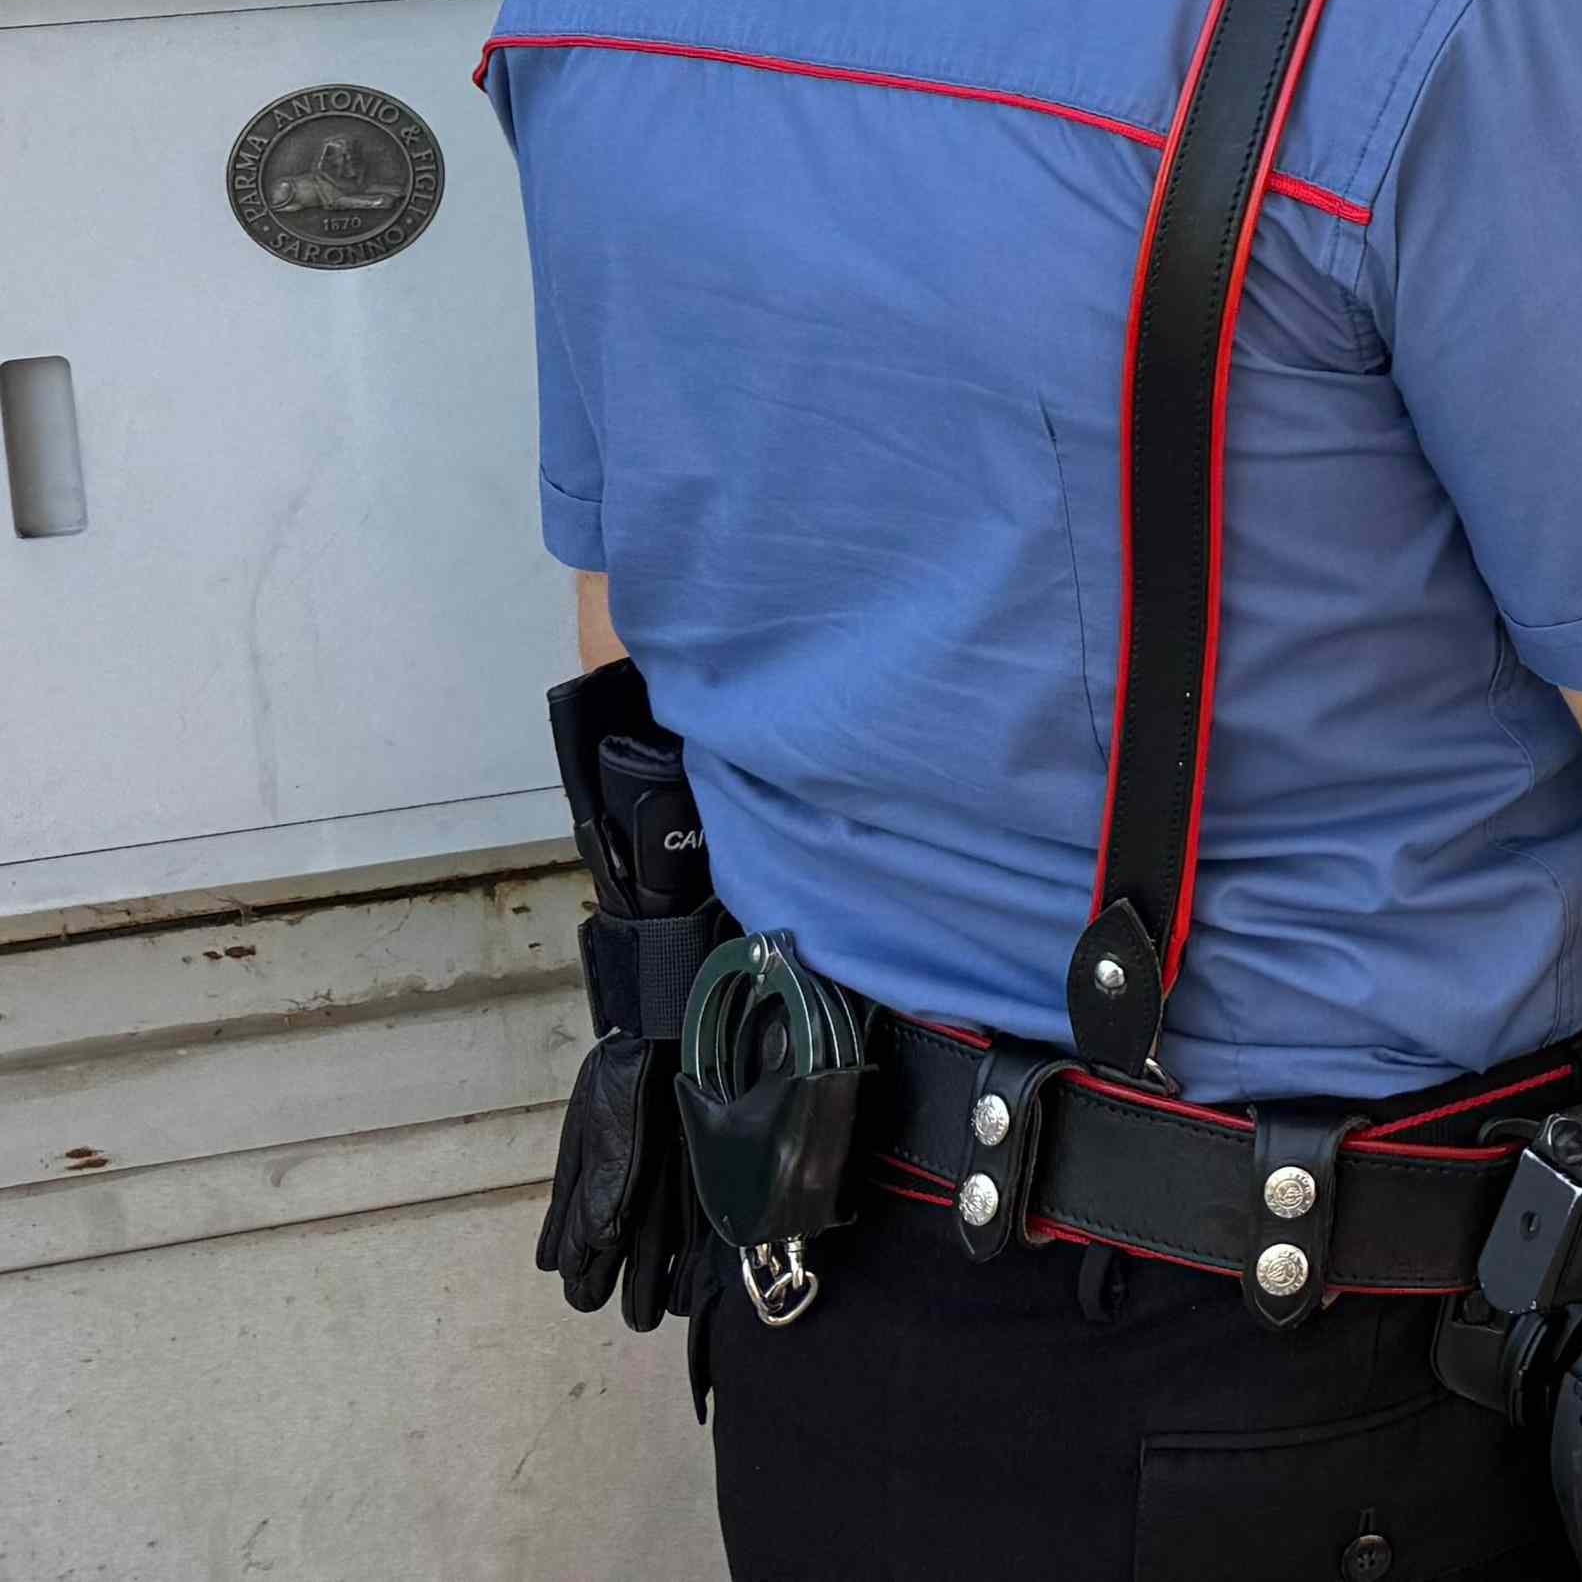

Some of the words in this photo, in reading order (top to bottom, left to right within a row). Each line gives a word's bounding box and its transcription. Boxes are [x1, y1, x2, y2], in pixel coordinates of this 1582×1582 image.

[272, 90, 400, 128] ANTONIO
[401, 125, 422, 146] &
[235, 134, 268, 224] PARMA
[410, 149, 438, 217] FIGLI
[270, 227, 405, 264] SARONNO
